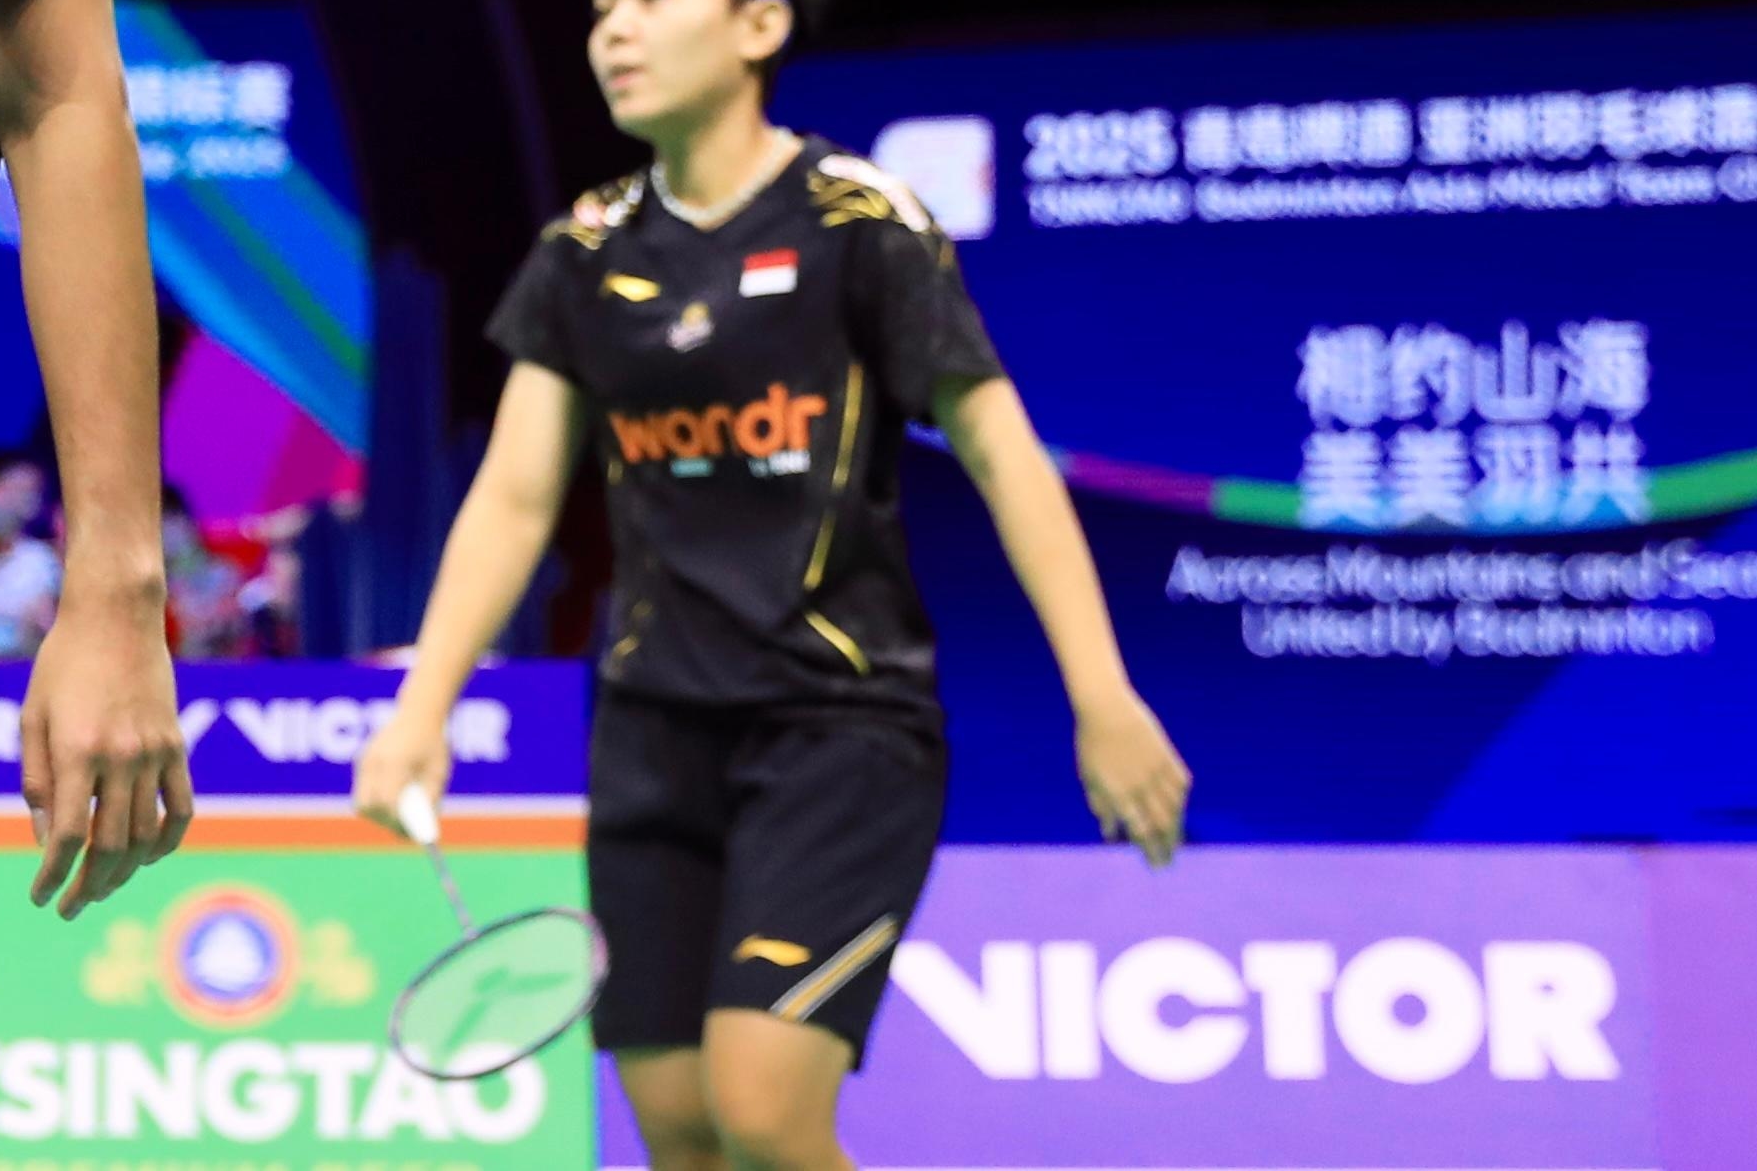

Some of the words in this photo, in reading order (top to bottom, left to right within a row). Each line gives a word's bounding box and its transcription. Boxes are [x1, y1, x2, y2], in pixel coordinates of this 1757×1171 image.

[609, 381, 828, 464] wondr
[223, 696, 512, 765] VICTR
[888, 934, 1623, 1086] VICTOR
